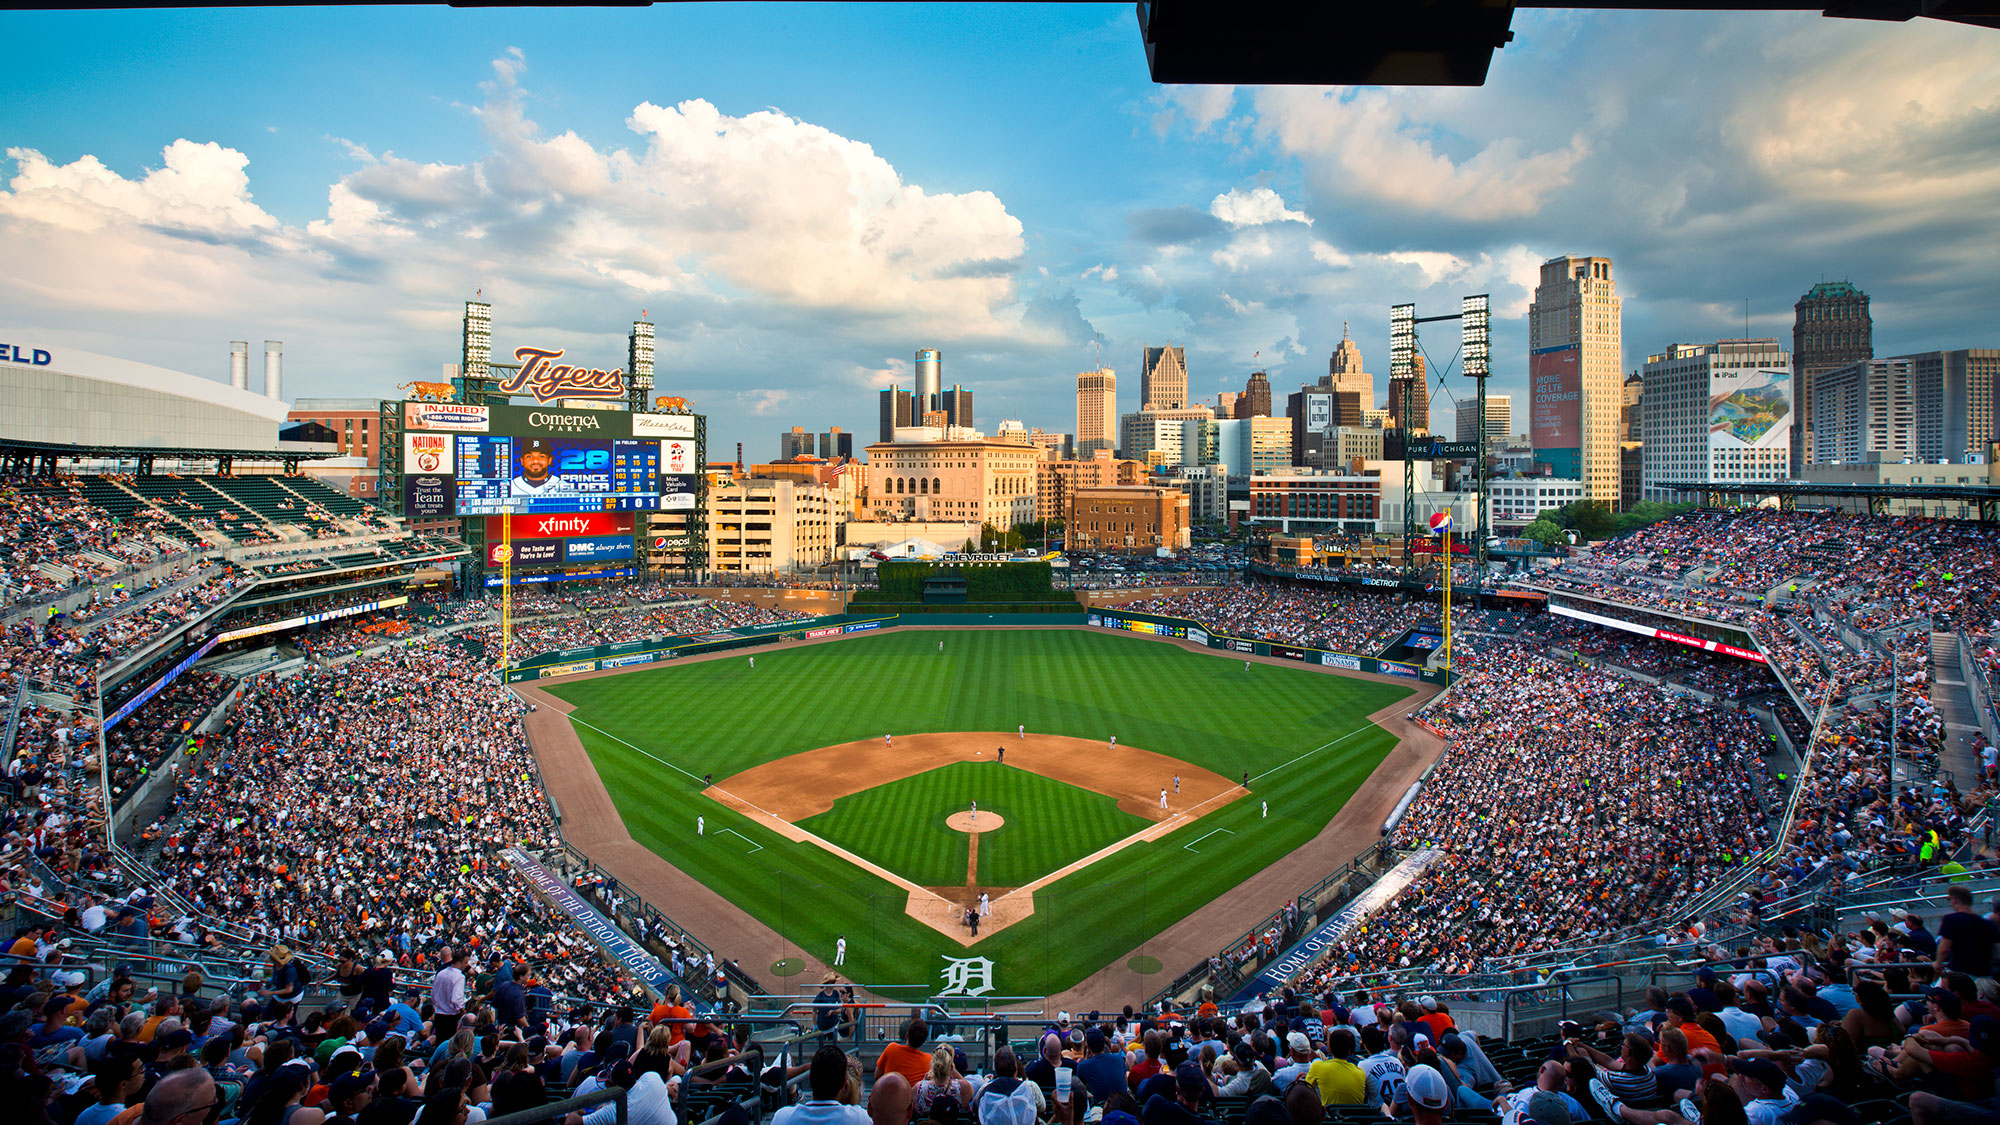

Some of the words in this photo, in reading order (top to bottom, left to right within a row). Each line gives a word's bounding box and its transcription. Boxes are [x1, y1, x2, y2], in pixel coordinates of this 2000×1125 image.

[499, 346, 625, 403] Tigers
[1536, 374, 1560, 385] MORE
[1536, 385, 1546, 393] 4G
[1548, 384, 1562, 393] LTE
[1536, 392, 1579, 403] COVERAGE
[424, 405, 485, 414] INJURED?
[1312, 414, 1328, 422] DETROIT
[413, 436, 445, 448] NATIONAL
[1423, 441, 1477, 457] MICHIGAN
[560, 450, 609, 469] 28
[560, 474, 609, 482] PRINCE
[544, 482, 610, 492] FIELDER
[413, 493, 443, 502] Team
[620, 498, 627, 508] 1
[635, 498, 642, 508] 0
[649, 498, 655, 507] 1
[538, 516, 590, 534] xfinity
[569, 543, 595, 551] DMC
[667, 537, 690, 547] pepsi
[943, 554, 1010, 562] CHEVROLET
[1324, 574, 1340, 582] Bank
[1371, 579, 1400, 588] DETROIT
[1325, 657, 1357, 667] DYNAMIC
[1392, 666, 1416, 674] TOTAL
[523, 864, 553, 887] HOME
[547, 885, 565, 896] OF
[559, 891, 583, 913] THE
[576, 909, 625, 951] DETROIT
[618, 945, 662, 982] TIGERS
[1265, 950, 1310, 982] HOME
[1305, 935, 1327, 951] OF
[1319, 919, 1347, 941] THE
[937, 955, 996, 997] D
[1370, 1063, 1385, 1080] KID
[1386, 1062, 1404, 1074] ROCK
